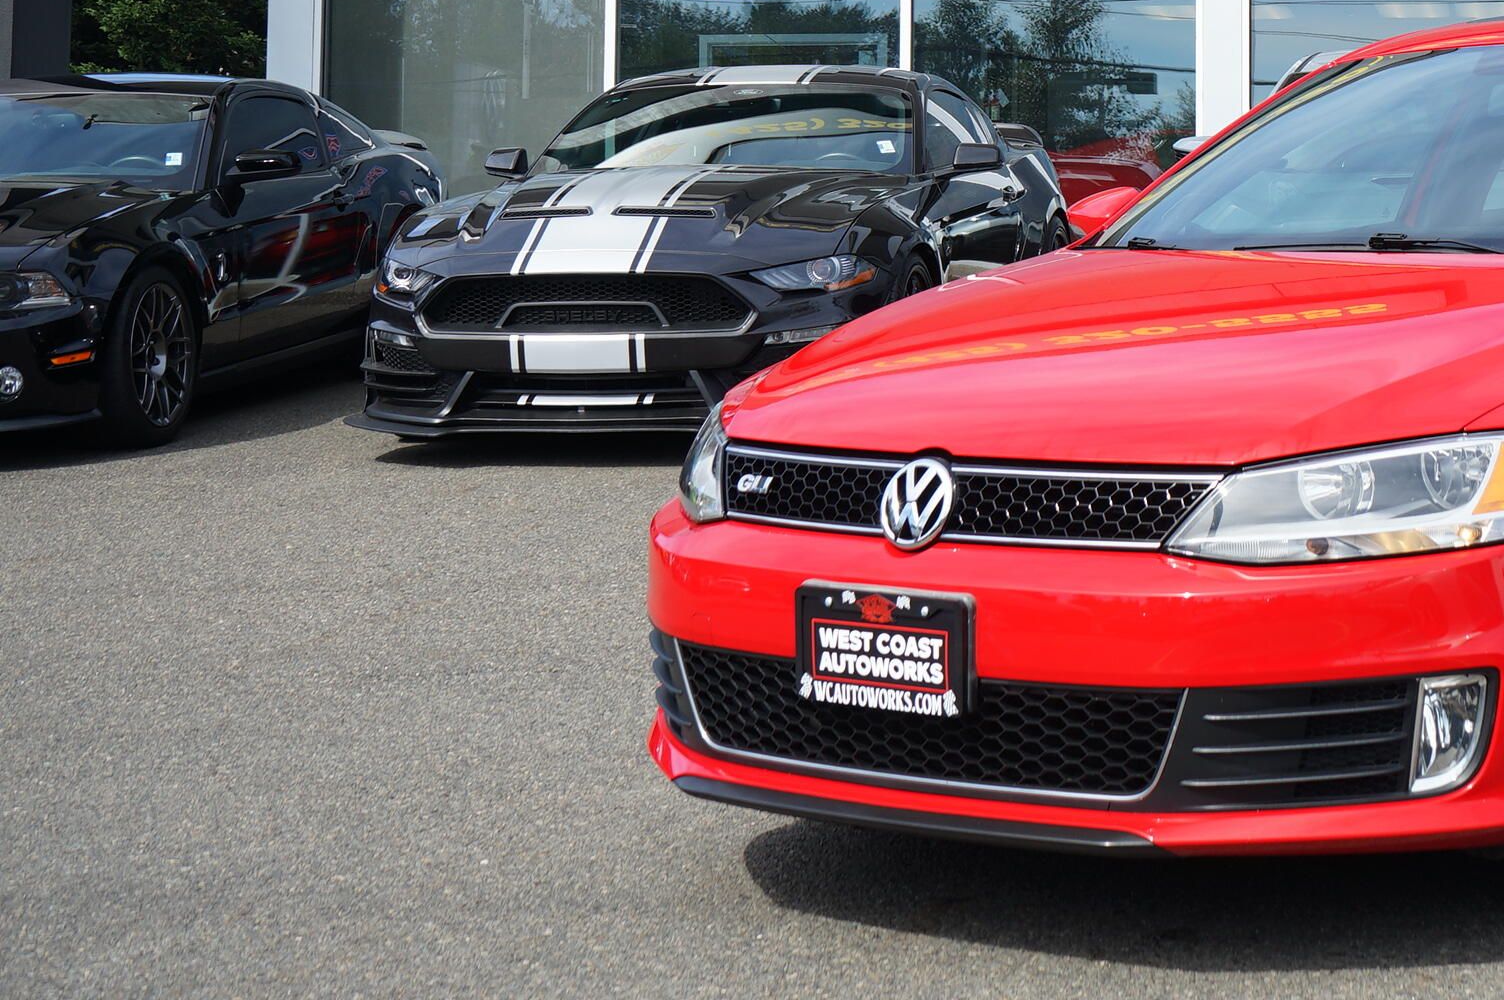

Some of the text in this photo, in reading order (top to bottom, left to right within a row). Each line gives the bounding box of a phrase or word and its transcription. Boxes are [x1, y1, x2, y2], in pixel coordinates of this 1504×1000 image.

[819, 627, 943, 660] WEST COAST
[819, 651, 944, 685] AUTOWORKS
[813, 680, 943, 717] WCAUTOWORKS.COM
